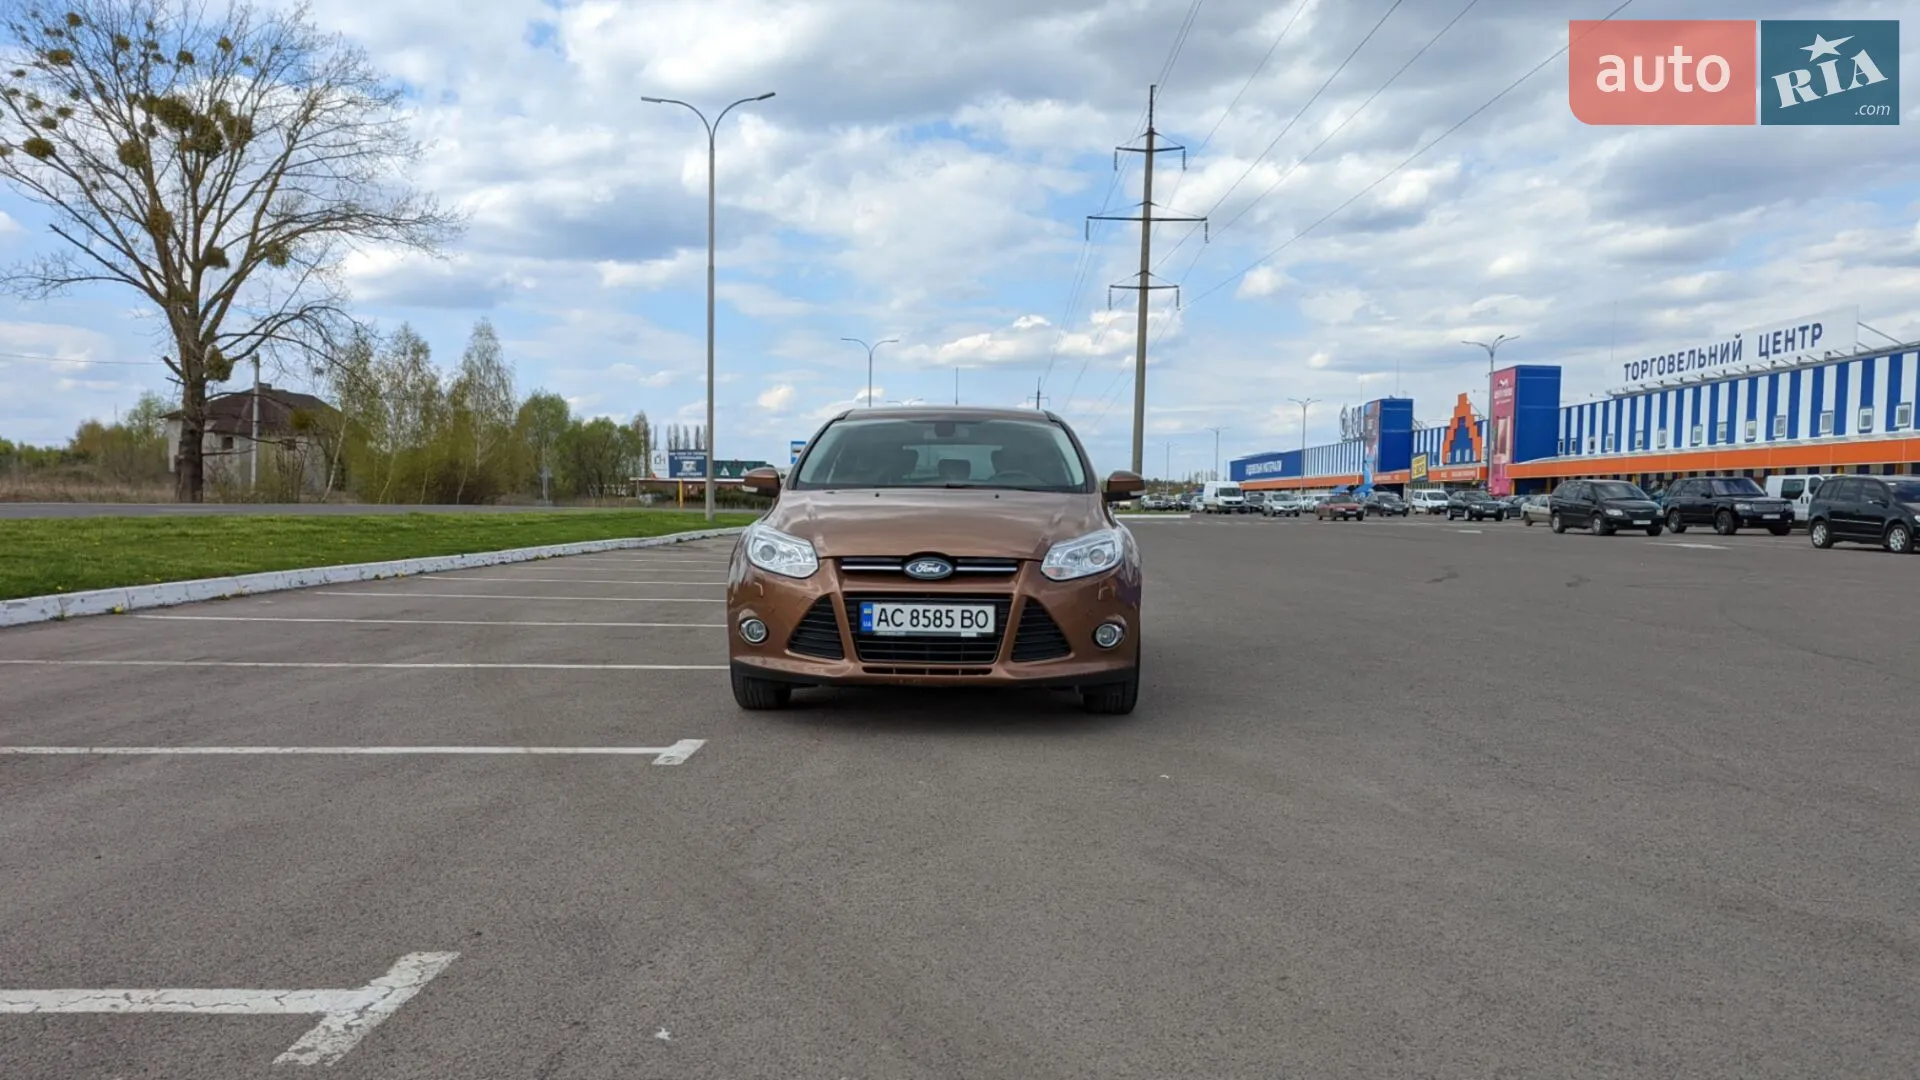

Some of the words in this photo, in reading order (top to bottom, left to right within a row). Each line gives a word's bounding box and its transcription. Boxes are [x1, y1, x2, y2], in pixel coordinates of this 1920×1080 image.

[1624, 333, 1743, 382] ТОРГОВЕЛЬНИЙ
[1758, 322, 1823, 359] ЦЕНТР
[915, 563, 942, 573] Ford
[876, 608, 905, 628] AC
[909, 609, 955, 628] 8585
[960, 609, 989, 629] BO
